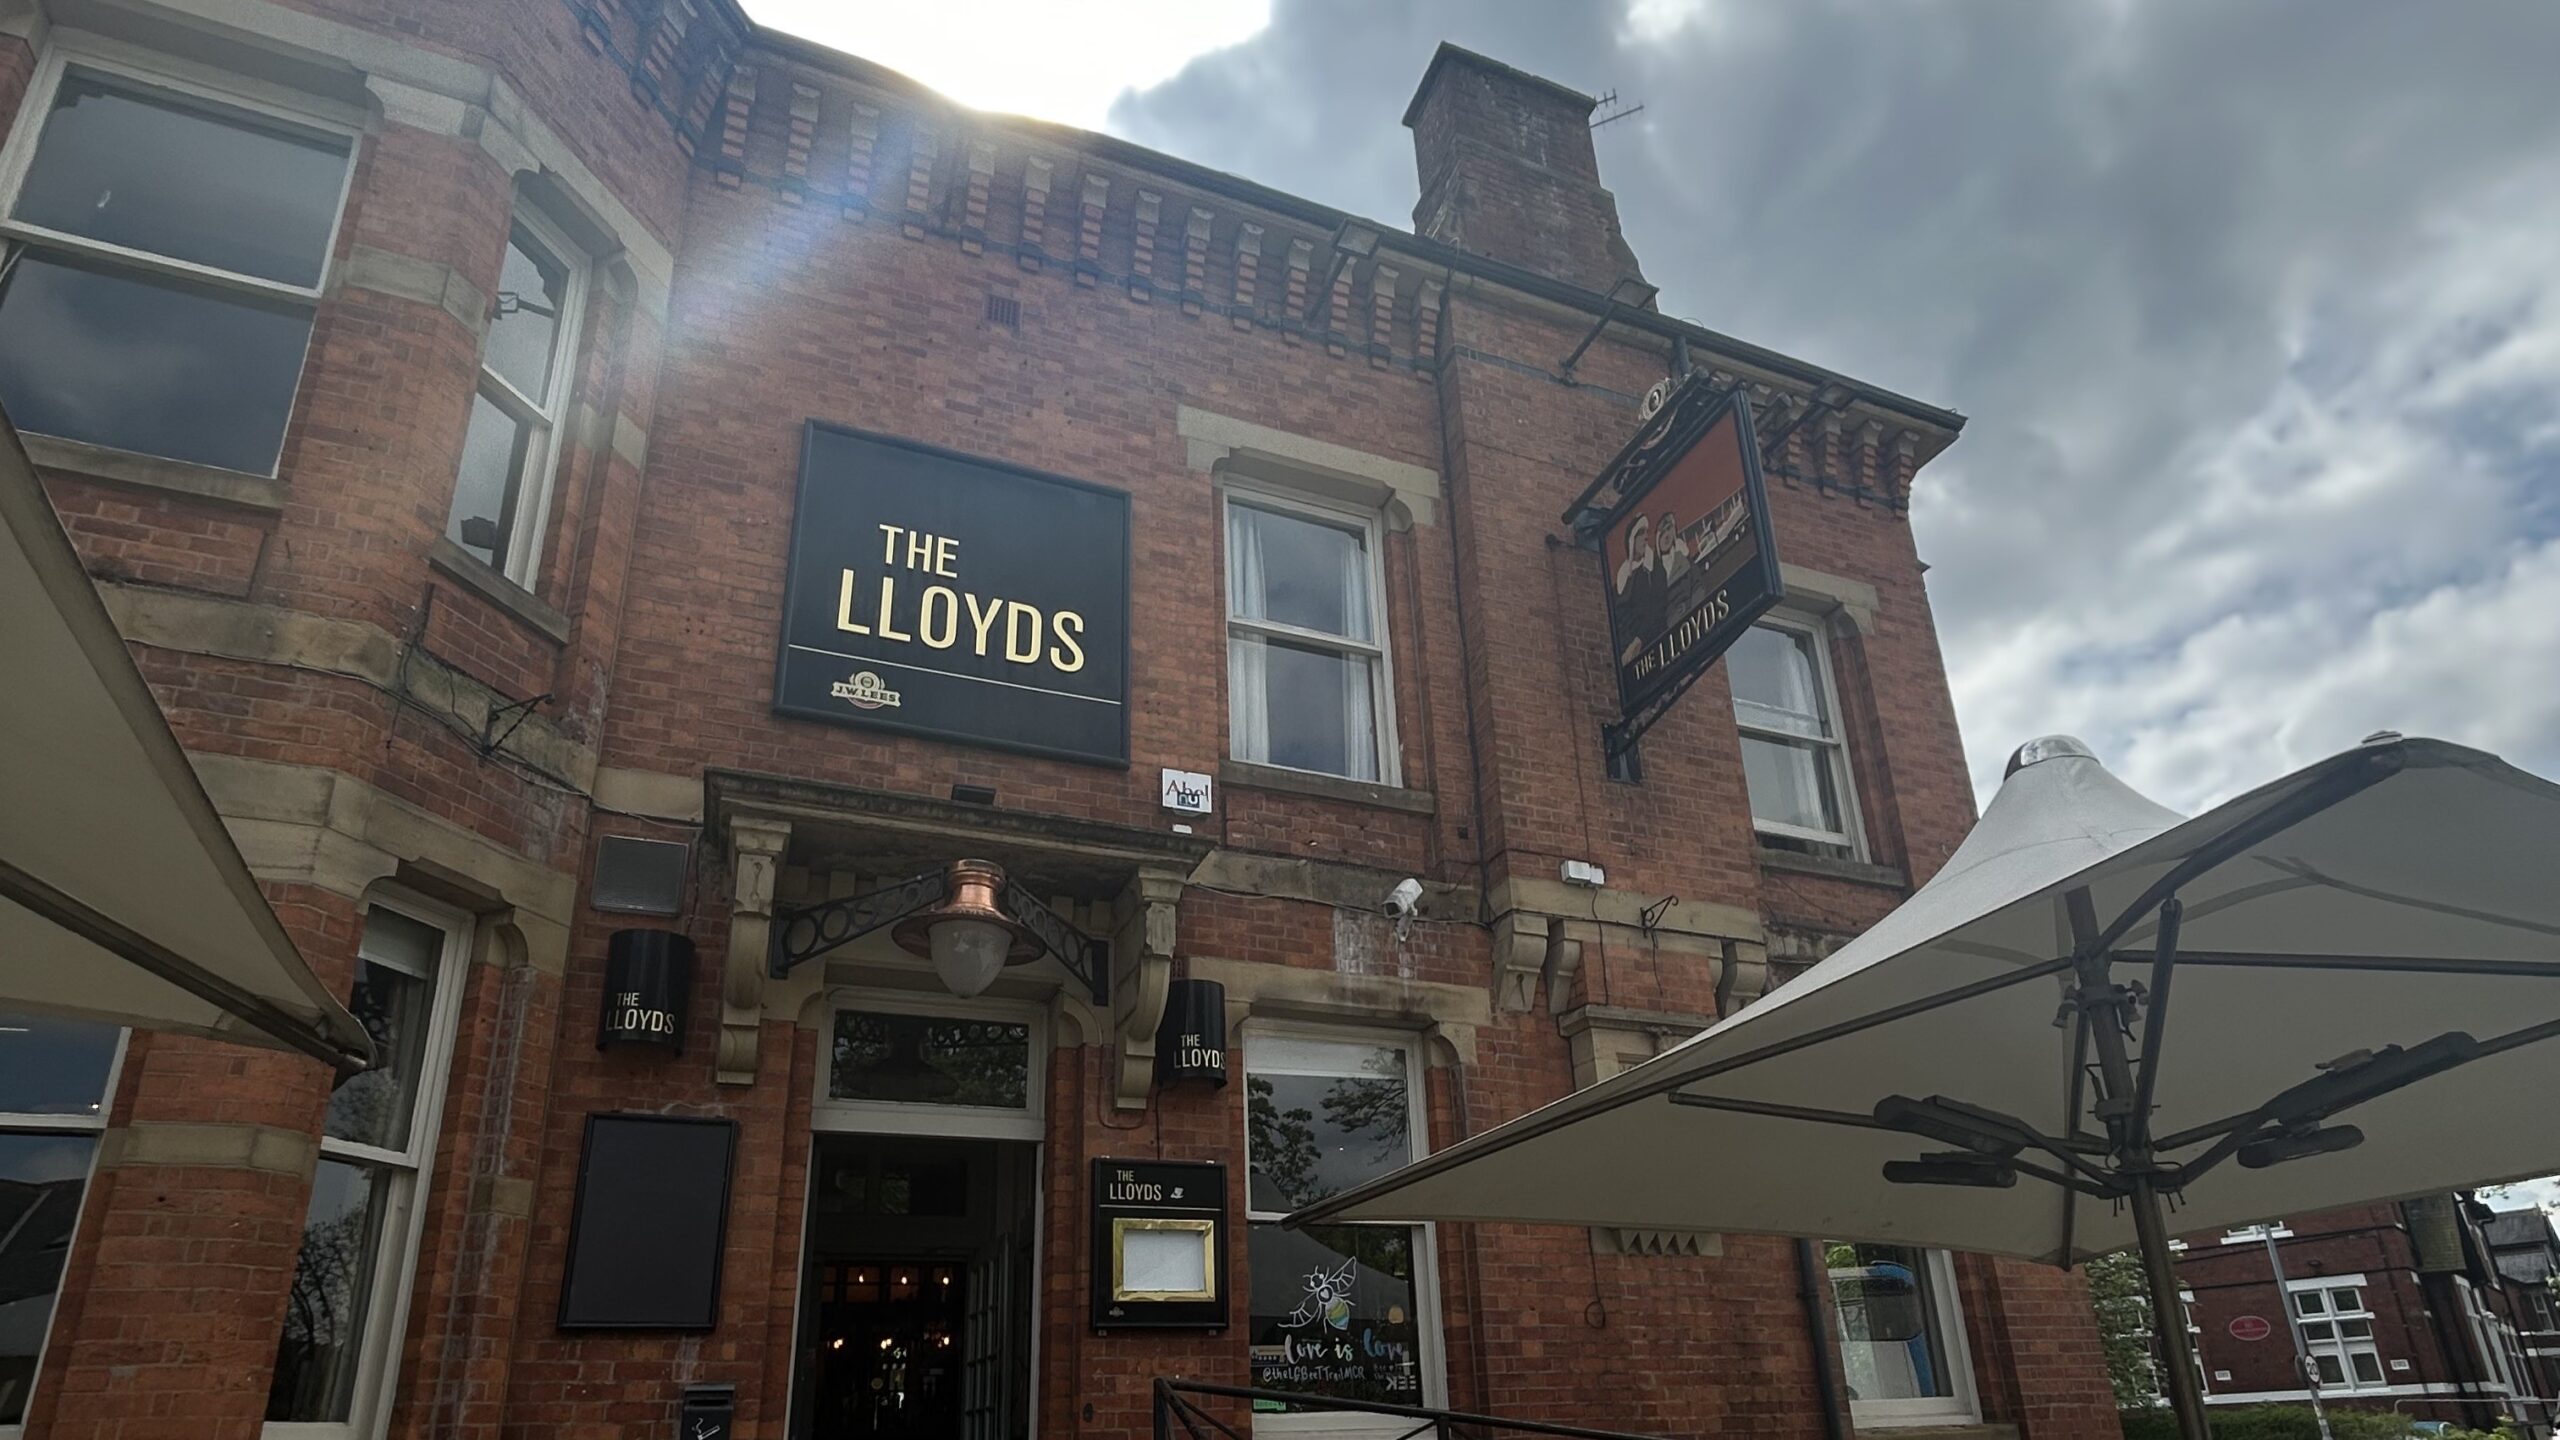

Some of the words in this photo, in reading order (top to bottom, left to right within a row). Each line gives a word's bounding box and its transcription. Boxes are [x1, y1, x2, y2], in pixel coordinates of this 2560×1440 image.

[879, 523, 960, 578] THE
[837, 568, 1085, 673] LLOYDS
[1634, 649, 1657, 681] THE
[1659, 589, 1730, 670] LLOYDS
[617, 991, 640, 1007] THE
[605, 1008, 676, 1035] LLOYDS
[1180, 1034, 1201, 1048] THE
[1173, 1048, 1226, 1070] LLOYDS
[1116, 1170, 1135, 1182] THE
[1109, 1183, 1162, 1201] LLOYDS
[1334, 1337, 1354, 1362] is
